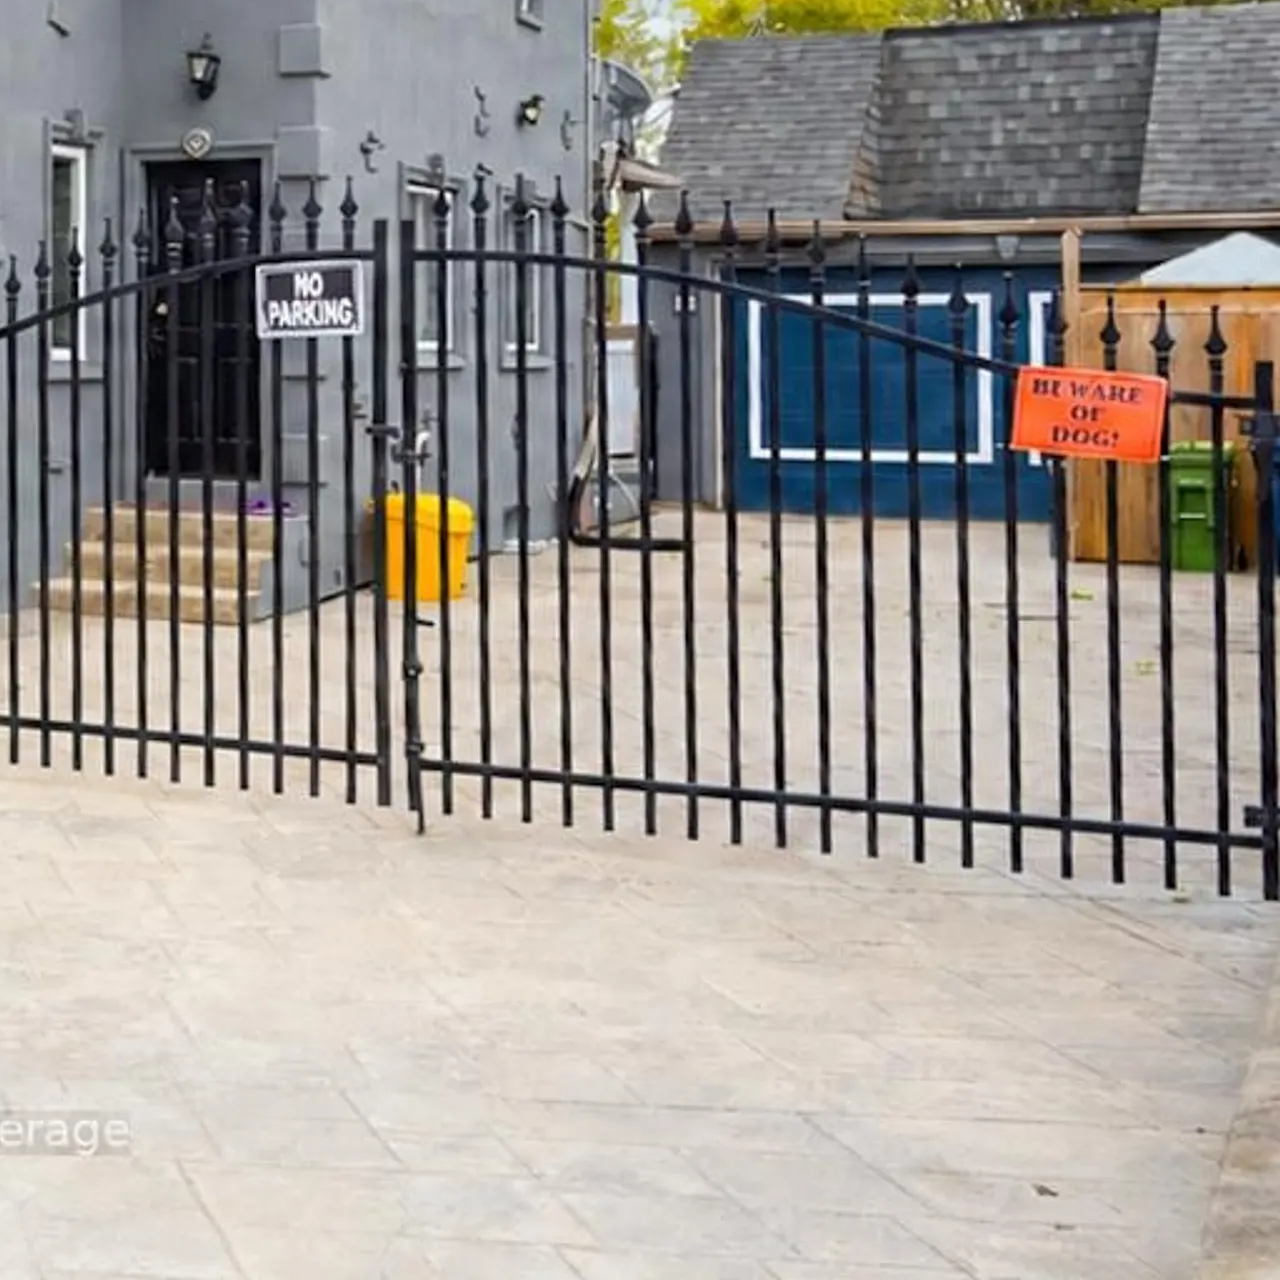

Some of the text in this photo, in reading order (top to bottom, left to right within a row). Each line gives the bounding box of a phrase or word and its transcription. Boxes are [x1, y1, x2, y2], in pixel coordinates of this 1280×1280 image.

[294, 272, 324, 297] NO
[268, 298, 353, 326] PARKING
[1033, 379, 1141, 403] BEWARE
[1071, 405, 1105, 421] OF
[1052, 426, 1119, 447] DOG!
